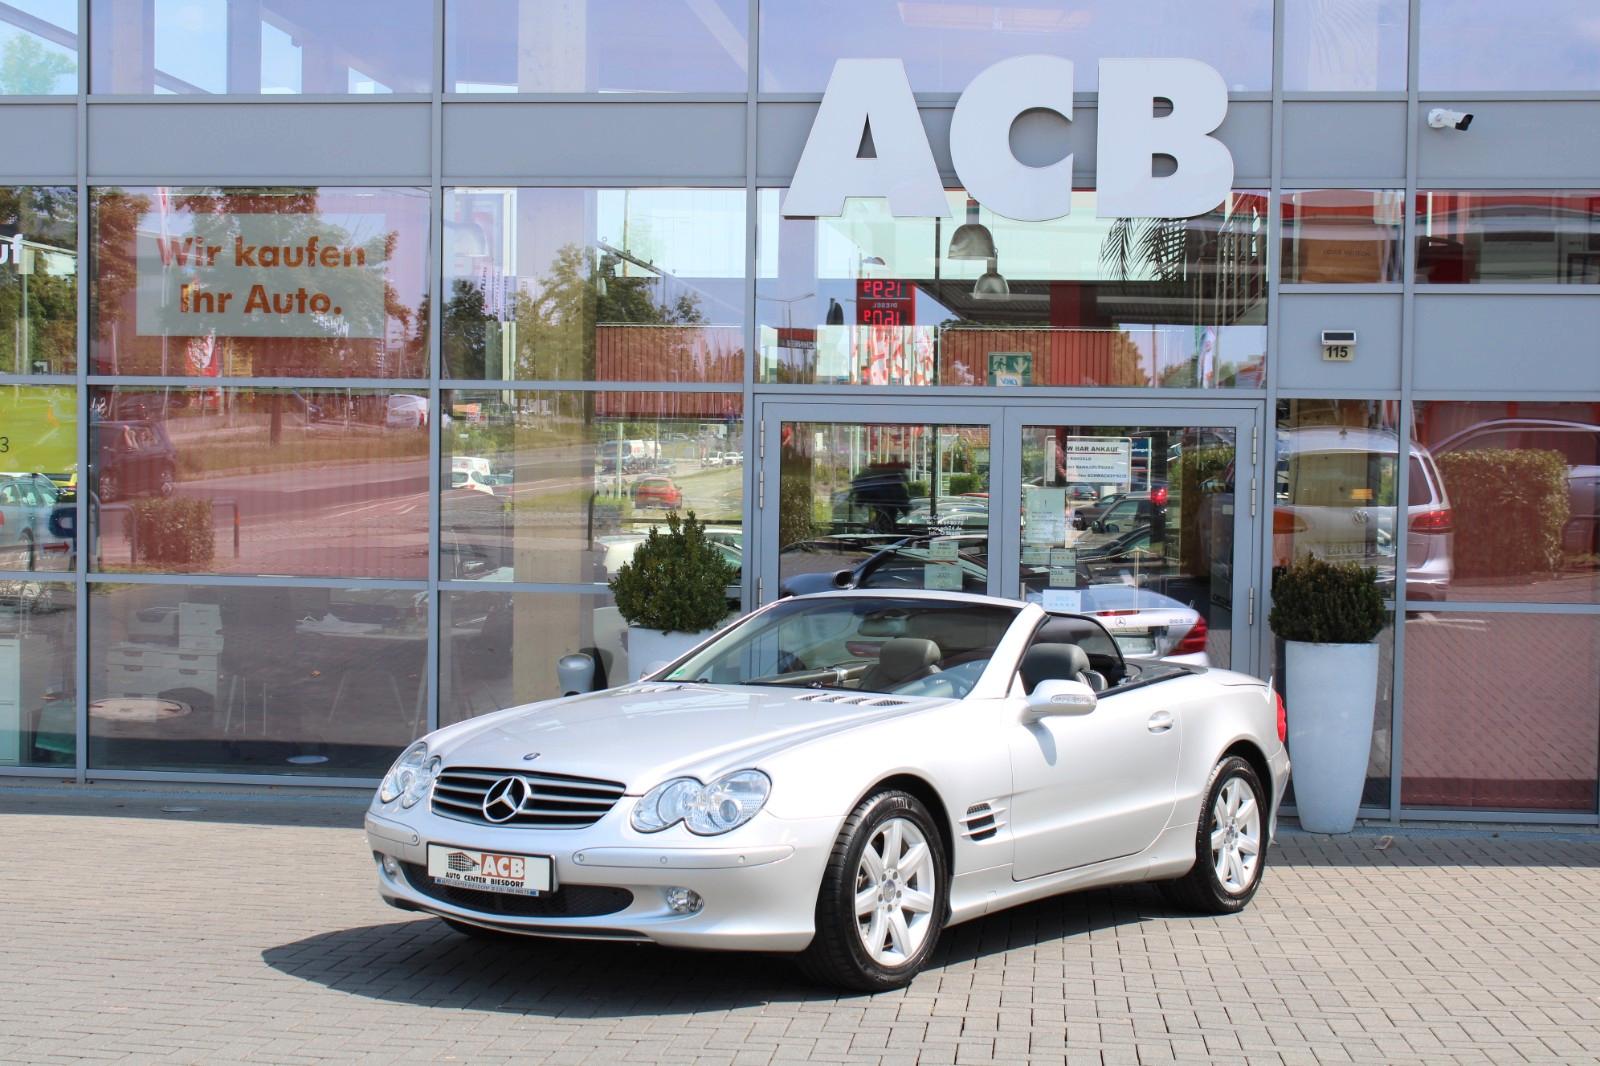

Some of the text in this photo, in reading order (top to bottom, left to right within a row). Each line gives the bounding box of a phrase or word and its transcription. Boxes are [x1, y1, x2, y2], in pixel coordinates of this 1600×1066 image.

[780, 54, 1234, 222] ACB
[156, 235, 366, 267] Wir kaufen
[180, 283, 343, 315] Ihr Auto.
[1326, 345, 1349, 358] 115
[445, 871, 461, 880] AUTO
[463, 874, 487, 884] CENTER
[490, 877, 525, 888] BIESDORF
[482, 853, 525, 879] ACB
